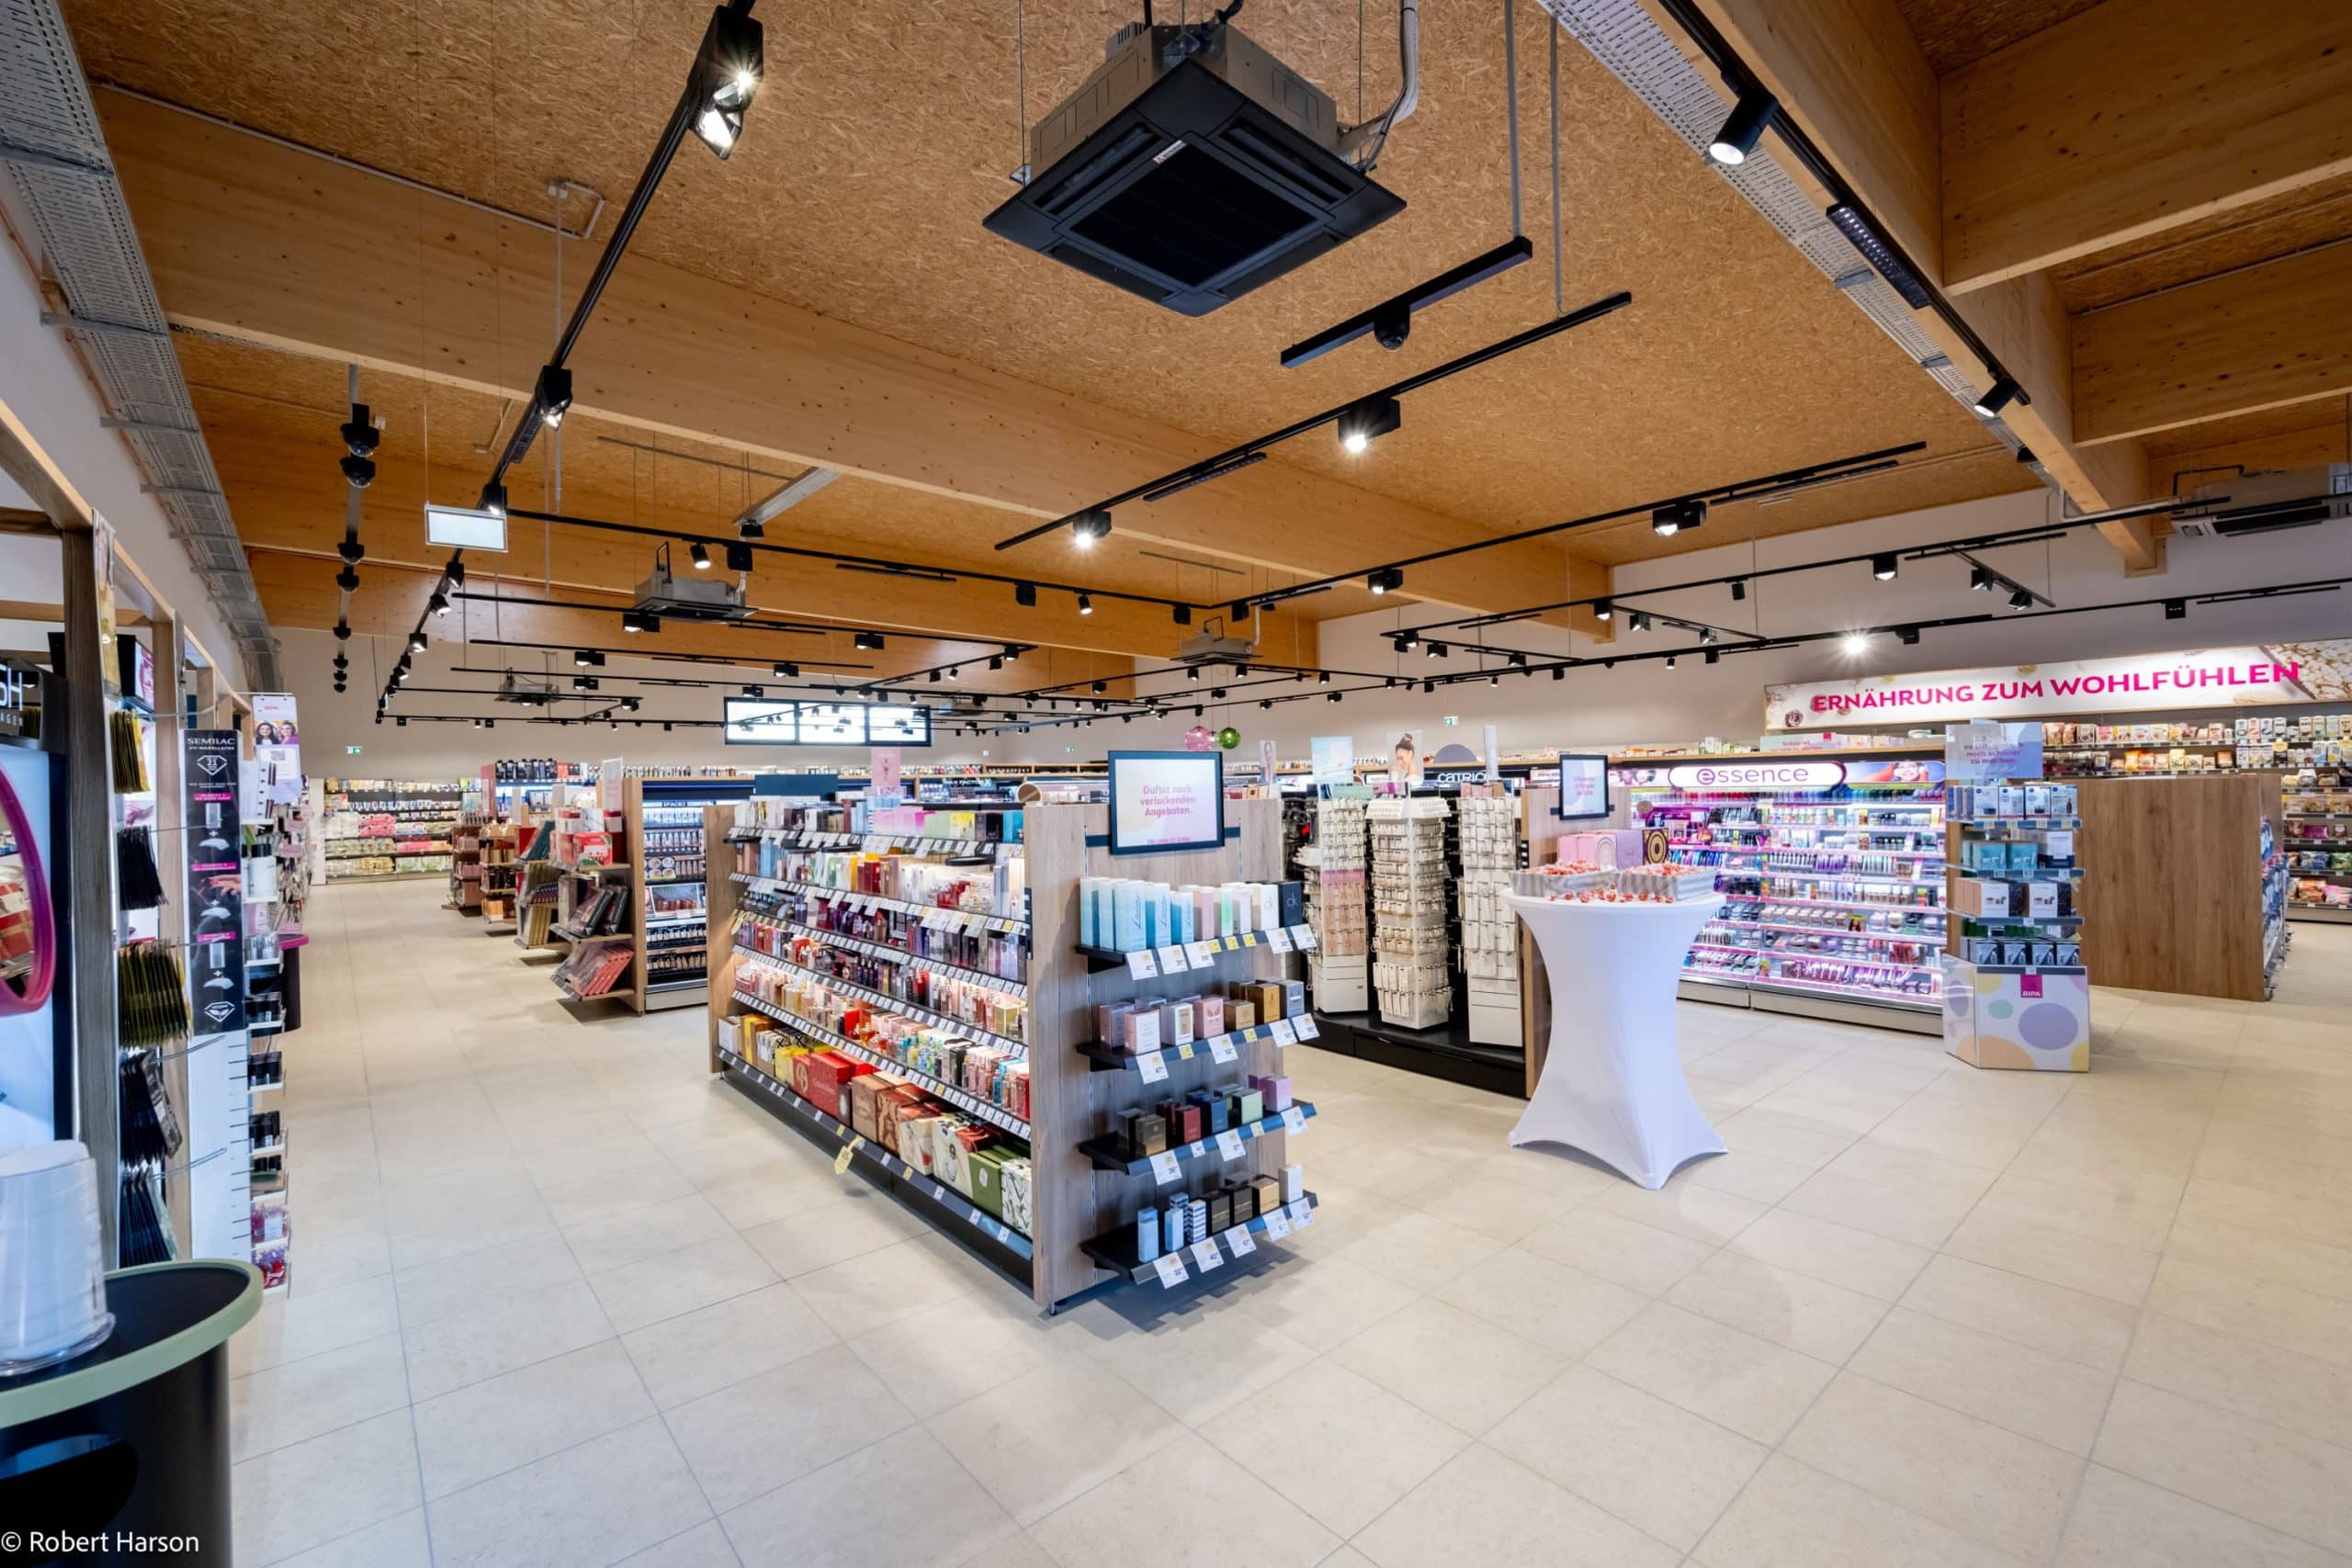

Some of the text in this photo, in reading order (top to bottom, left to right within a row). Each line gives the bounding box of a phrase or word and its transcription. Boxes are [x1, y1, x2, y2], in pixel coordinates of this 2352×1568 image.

[1813, 661, 2301, 713] ERNÄHRUNG ZUM WOHLFÜHLEN
[1697, 768, 1809, 784] essence
